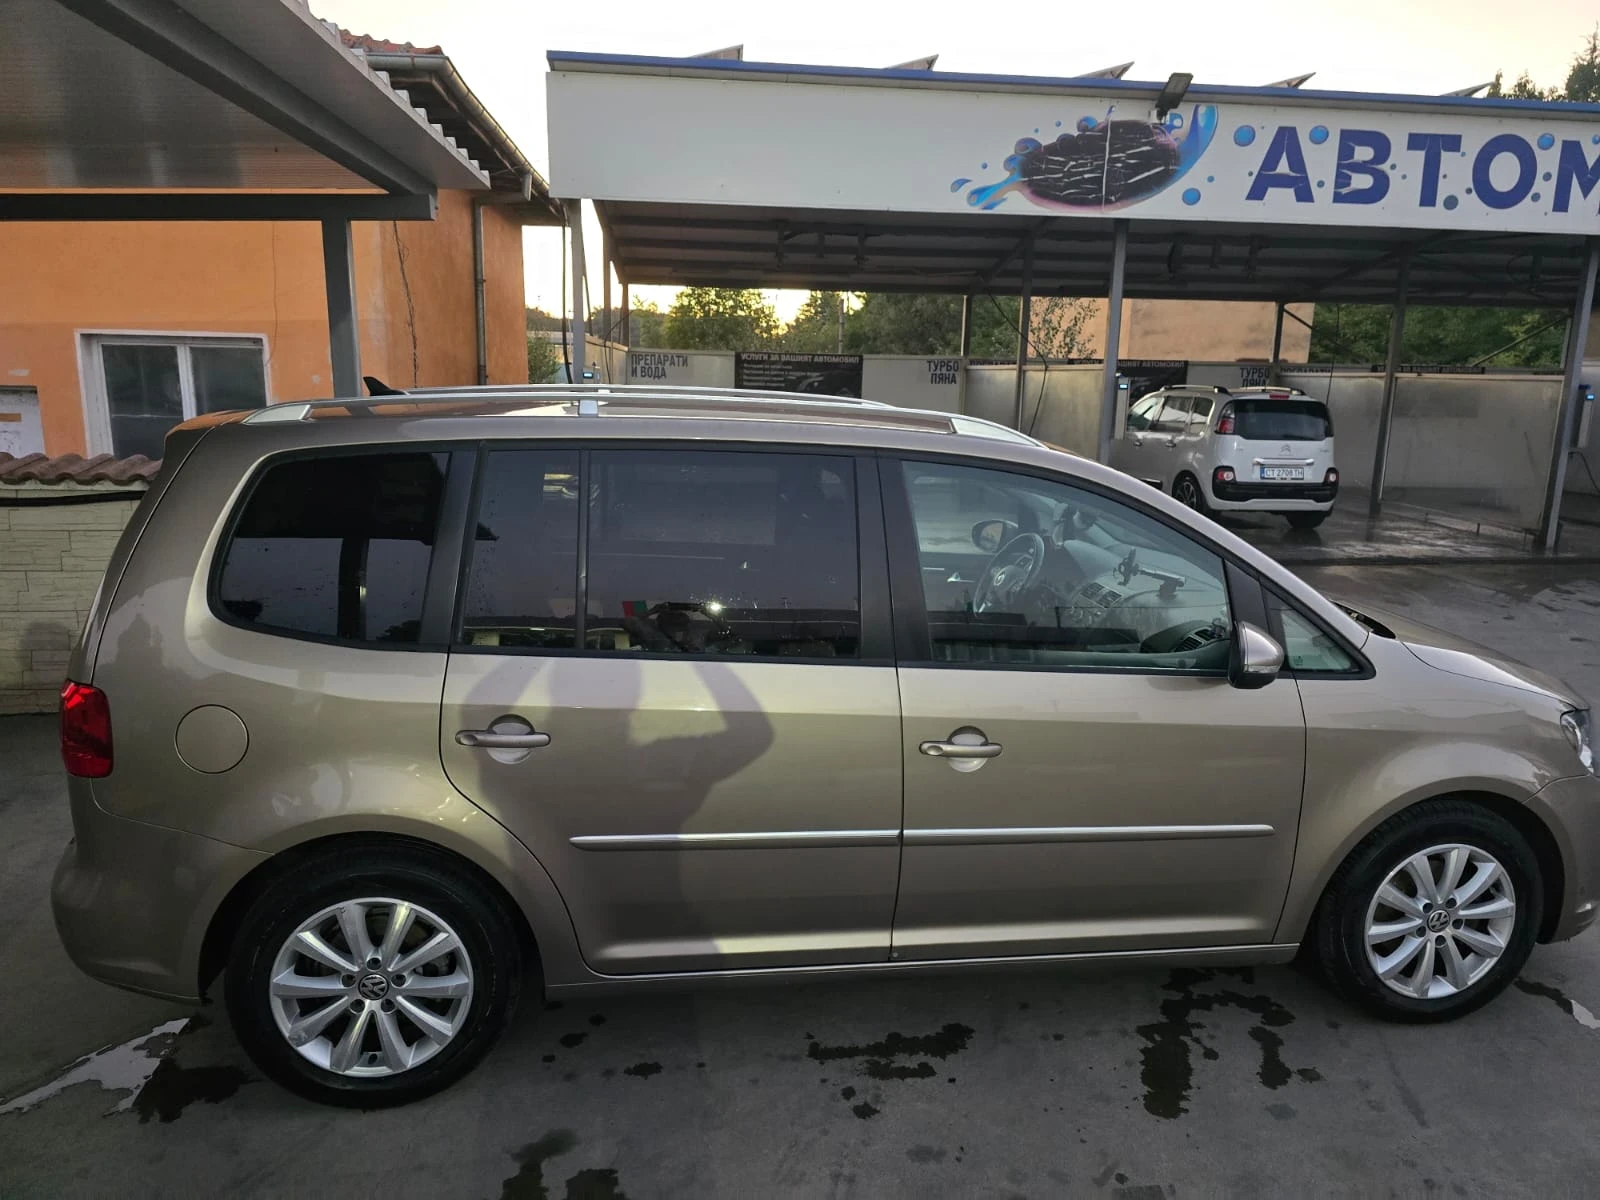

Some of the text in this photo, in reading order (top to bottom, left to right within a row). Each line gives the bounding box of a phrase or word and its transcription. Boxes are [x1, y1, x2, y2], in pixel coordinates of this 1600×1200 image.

[1245, 126, 1600, 213] АВТОМ
[631, 354, 688, 367] ПРЕПАРАТИ
[928, 361, 959, 372] ТУРБО
[631, 367, 667, 380] И ВОДА
[930, 373, 957, 385] ПЯНА
[1240, 368, 1270, 378] ТУРБО
